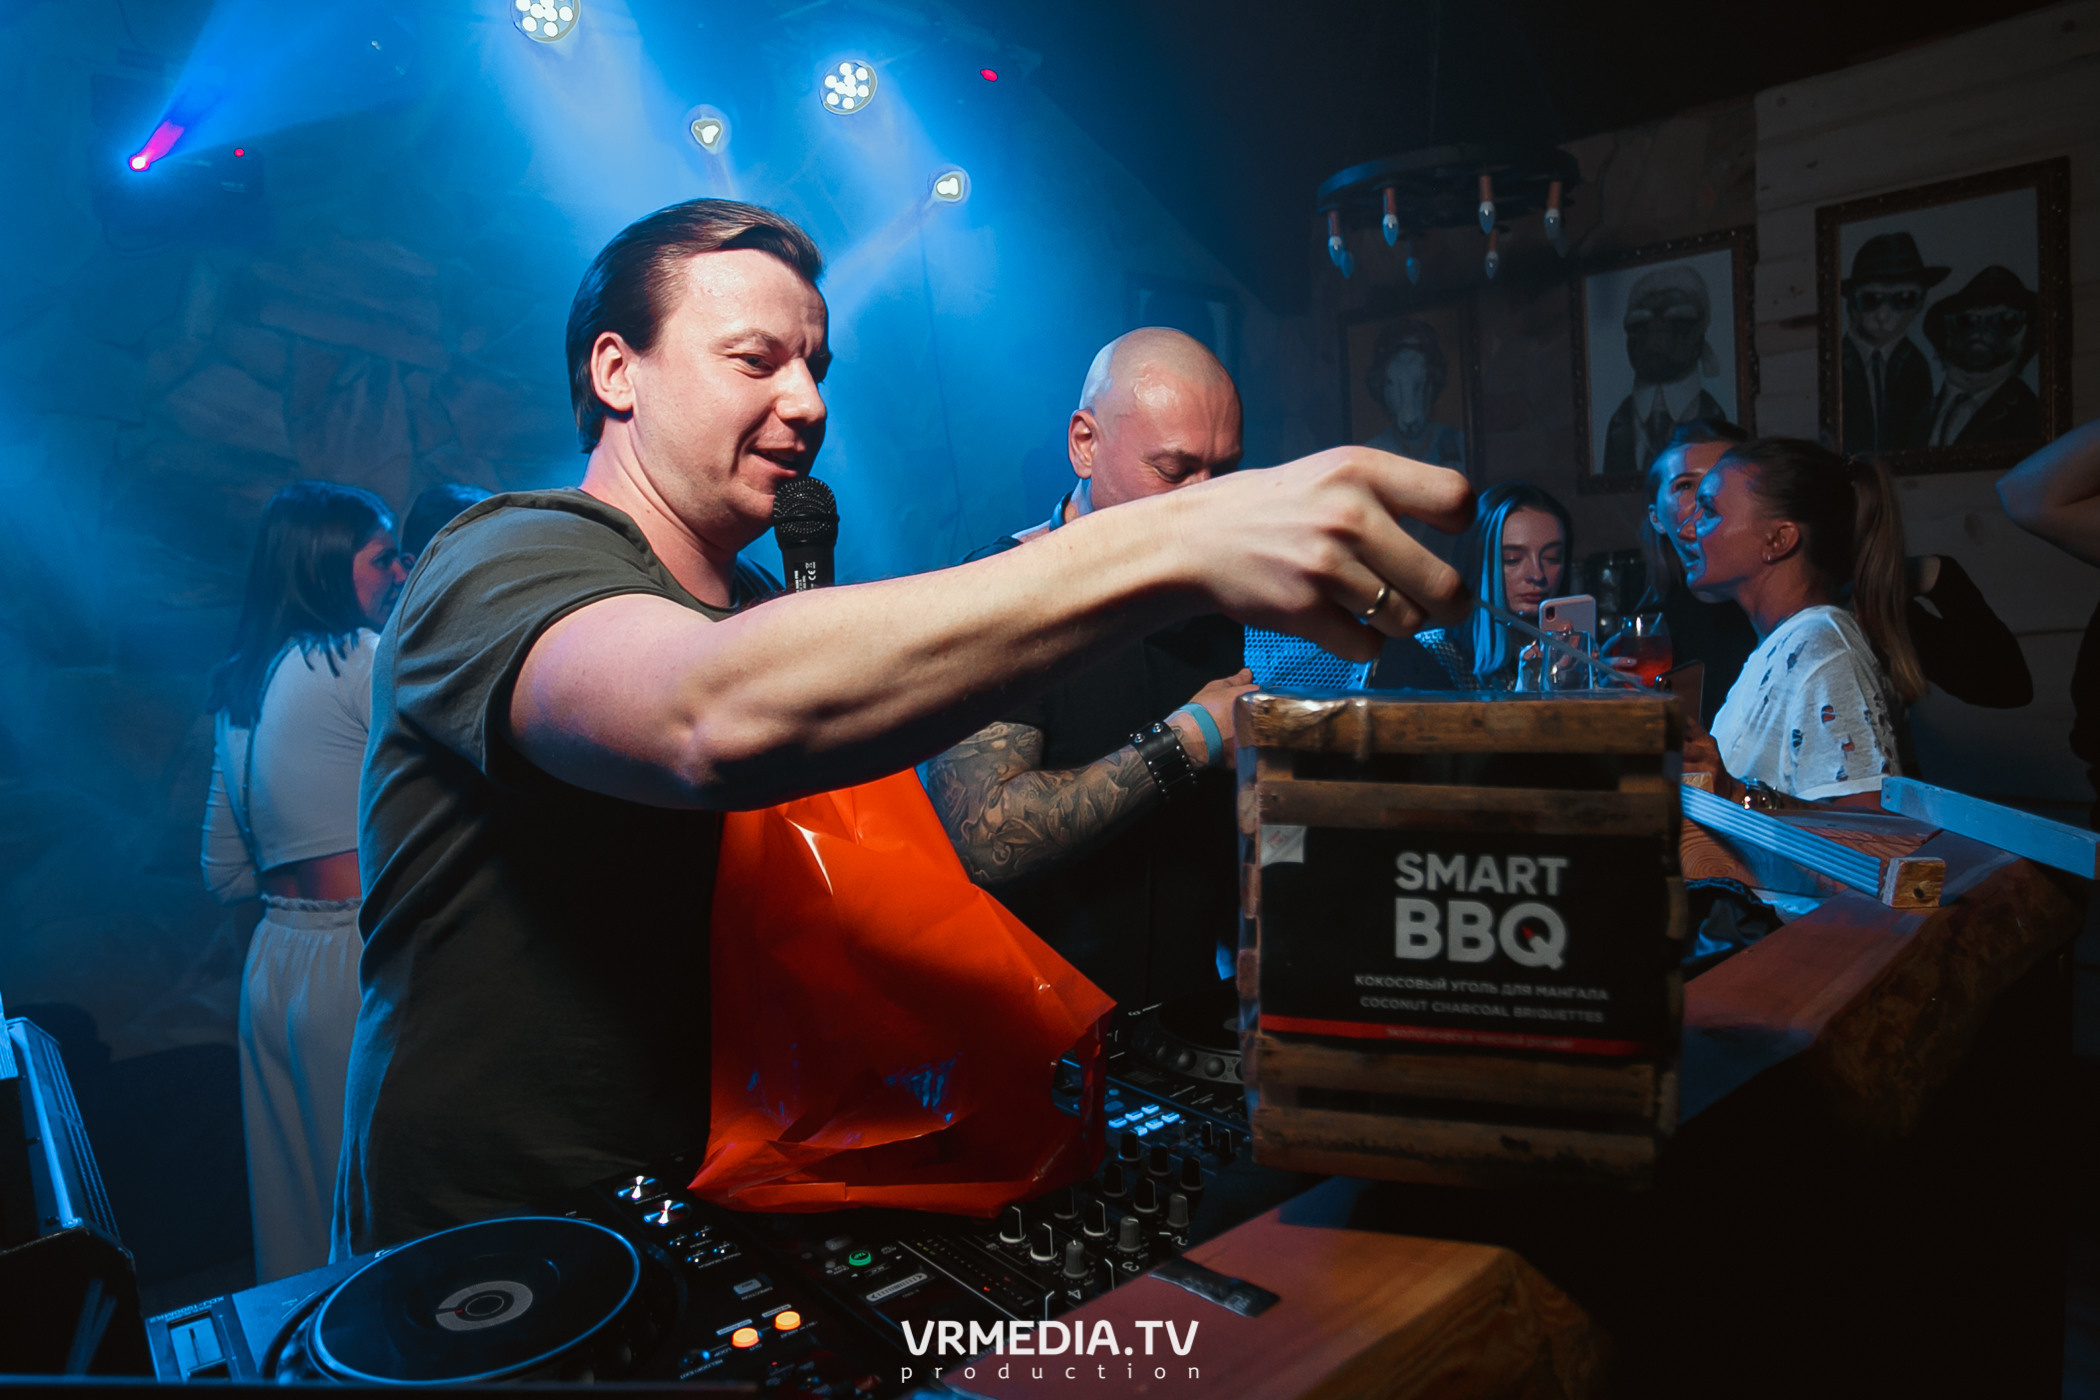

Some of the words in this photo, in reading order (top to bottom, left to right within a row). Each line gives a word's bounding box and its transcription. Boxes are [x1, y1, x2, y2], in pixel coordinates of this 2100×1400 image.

[1395, 851, 1569, 896] SMART
[1395, 897, 1567, 970] BBQ
[1354, 974, 1447, 991] КОКОСОВЫЙ
[1450, 981, 1498, 994] УГОЛЬ
[1501, 984, 1532, 996] ДЛЯ
[1535, 985, 1609, 1000] МАНГАЛА
[1359, 997, 1427, 1011] COCONUT
[1431, 1001, 1509, 1018] CHARCOAL
[1513, 1006, 1605, 1023] BRIQUETTES
[1122, 1261, 1139, 1272] 3
[1067, 1289, 1082, 1300] 4
